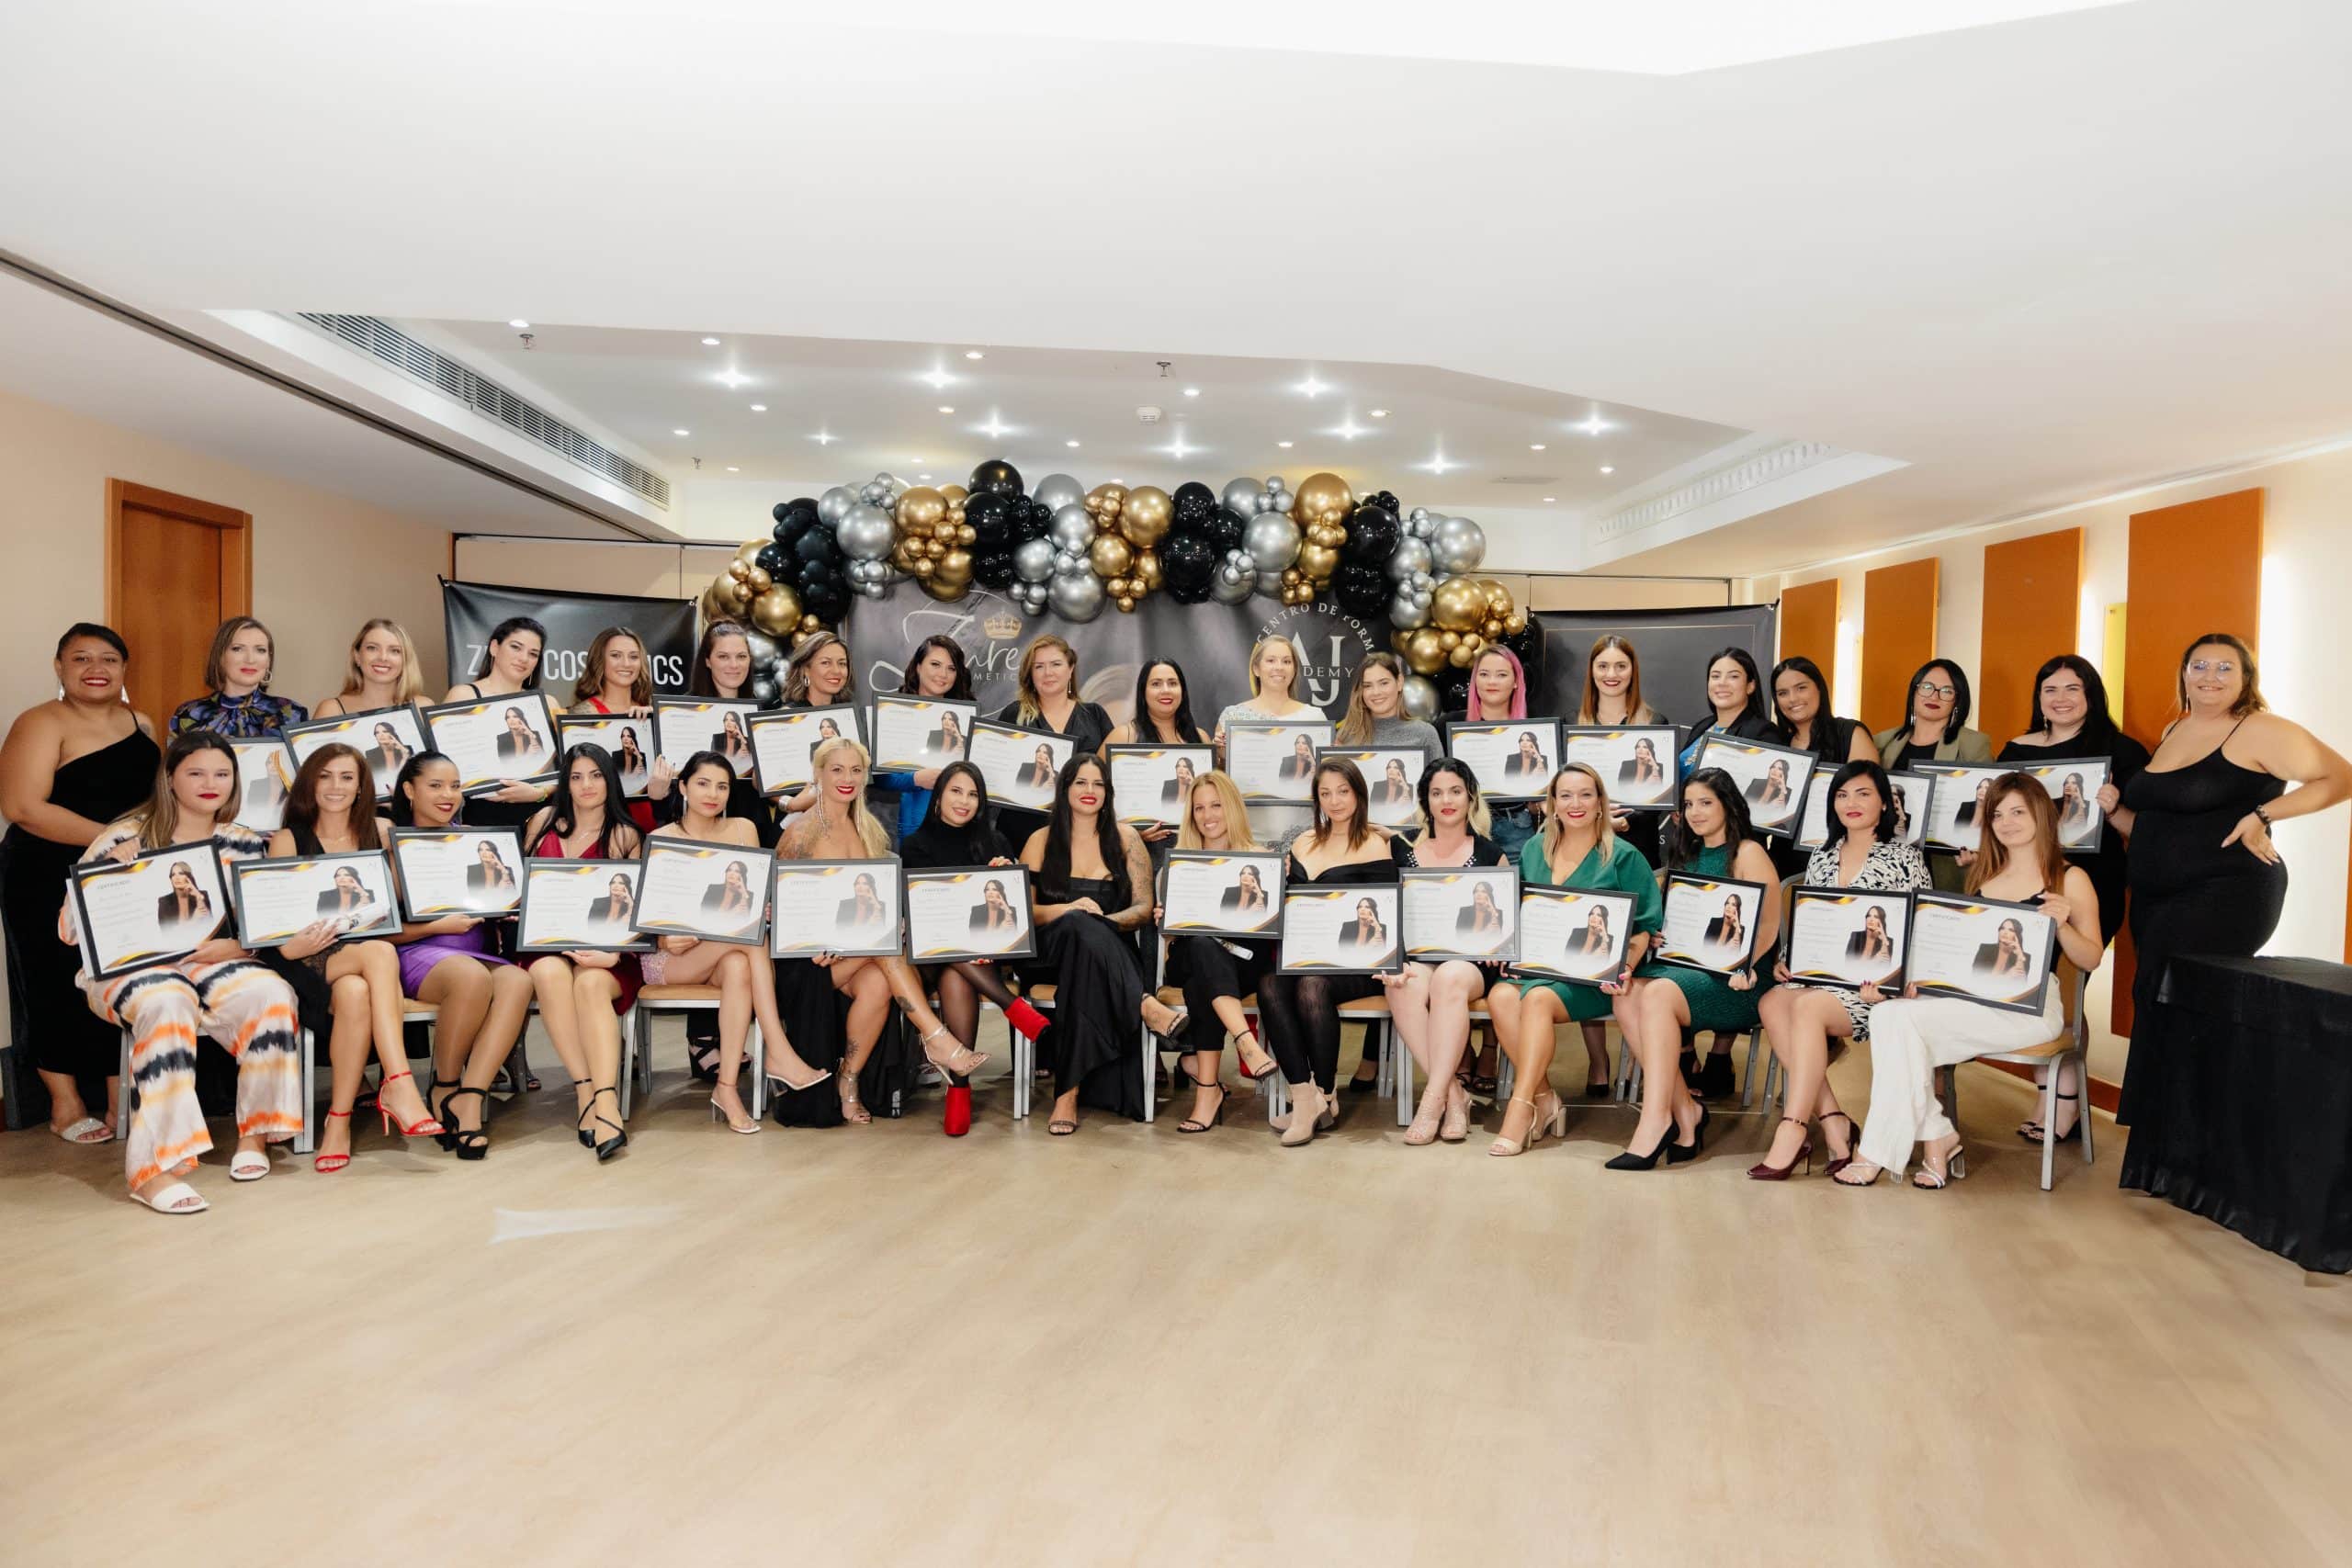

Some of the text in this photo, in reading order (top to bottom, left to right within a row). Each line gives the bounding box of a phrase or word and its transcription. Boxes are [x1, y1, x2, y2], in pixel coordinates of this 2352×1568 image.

[1257, 604, 1310, 645] CENTRO
[1318, 603, 1339, 615] DE
[543, 649, 684, 685] COSICS
[973, 672, 1016, 681] METIC
[1304, 667, 1354, 678] DEMY
